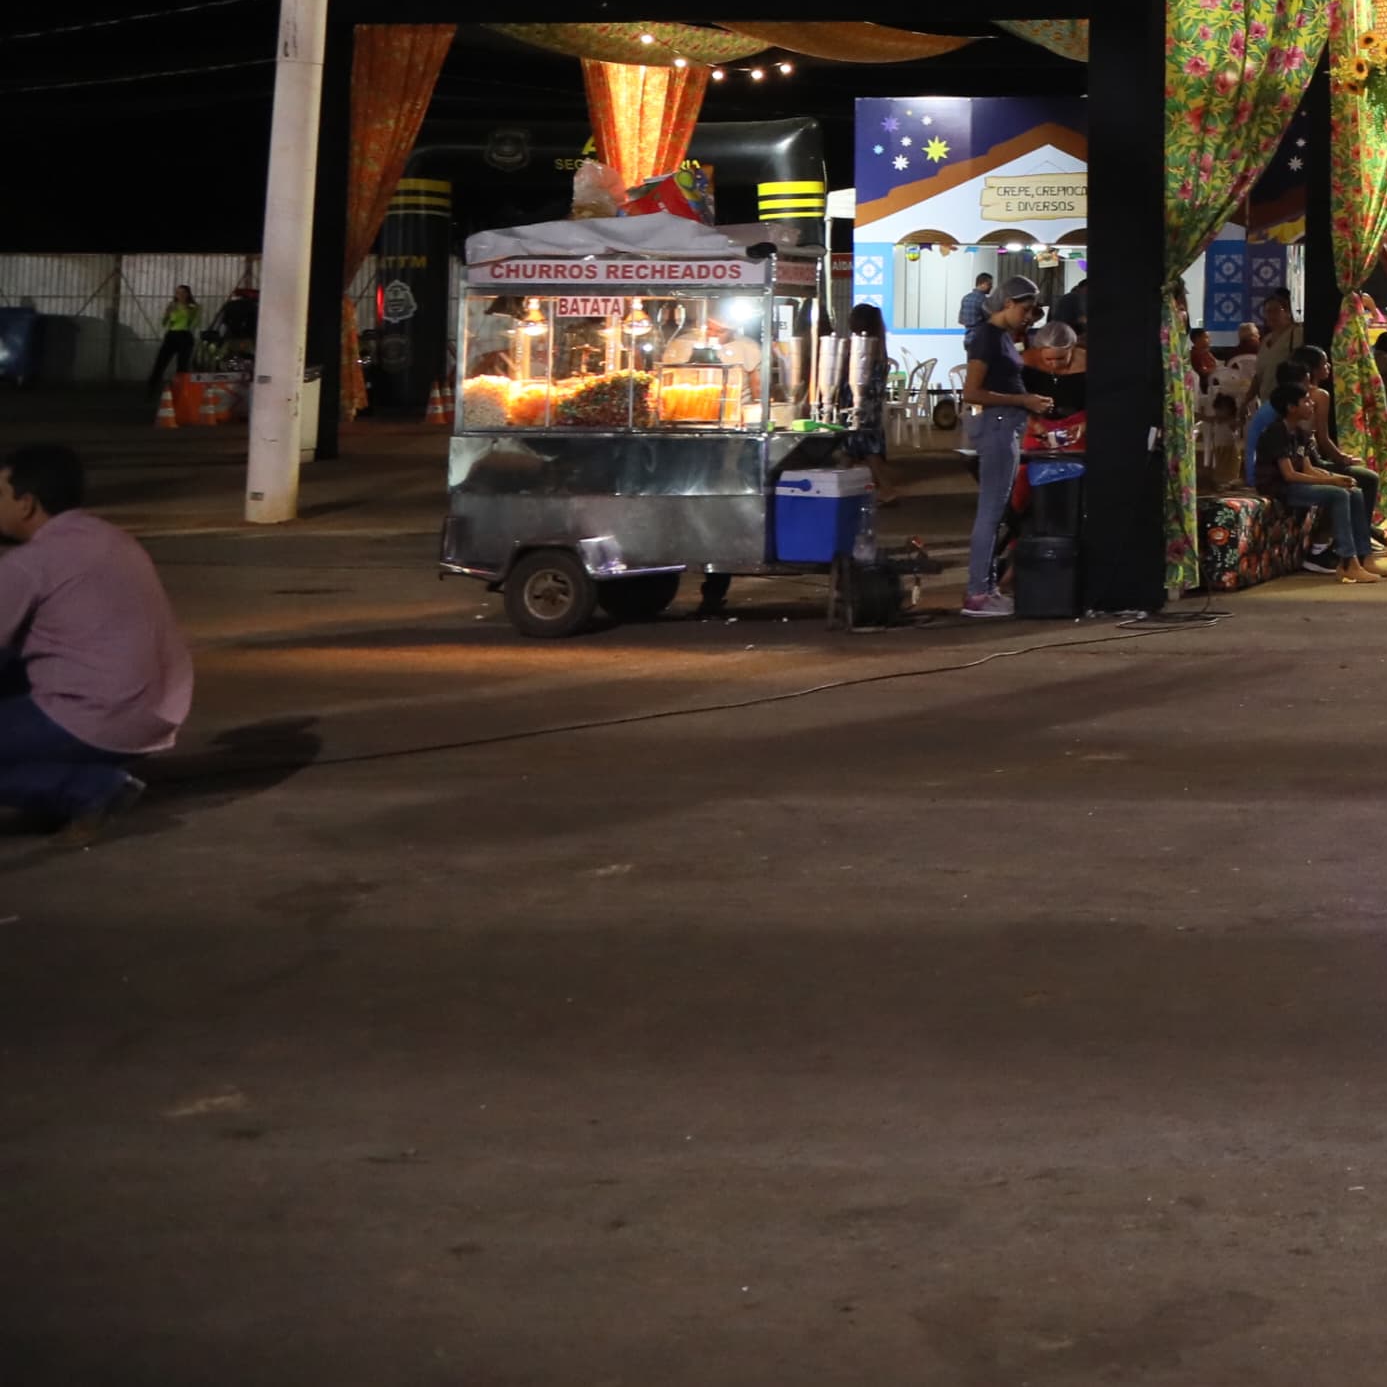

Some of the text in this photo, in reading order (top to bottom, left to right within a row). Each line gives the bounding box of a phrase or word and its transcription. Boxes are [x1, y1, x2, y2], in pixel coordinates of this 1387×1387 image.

[996, 185, 1034, 198] CREPE,
[1005, 200, 1075, 212] E DIVERSOS
[490, 263, 742, 280] CHURROS RECHEADOS
[558, 298, 622, 315] BATATA
